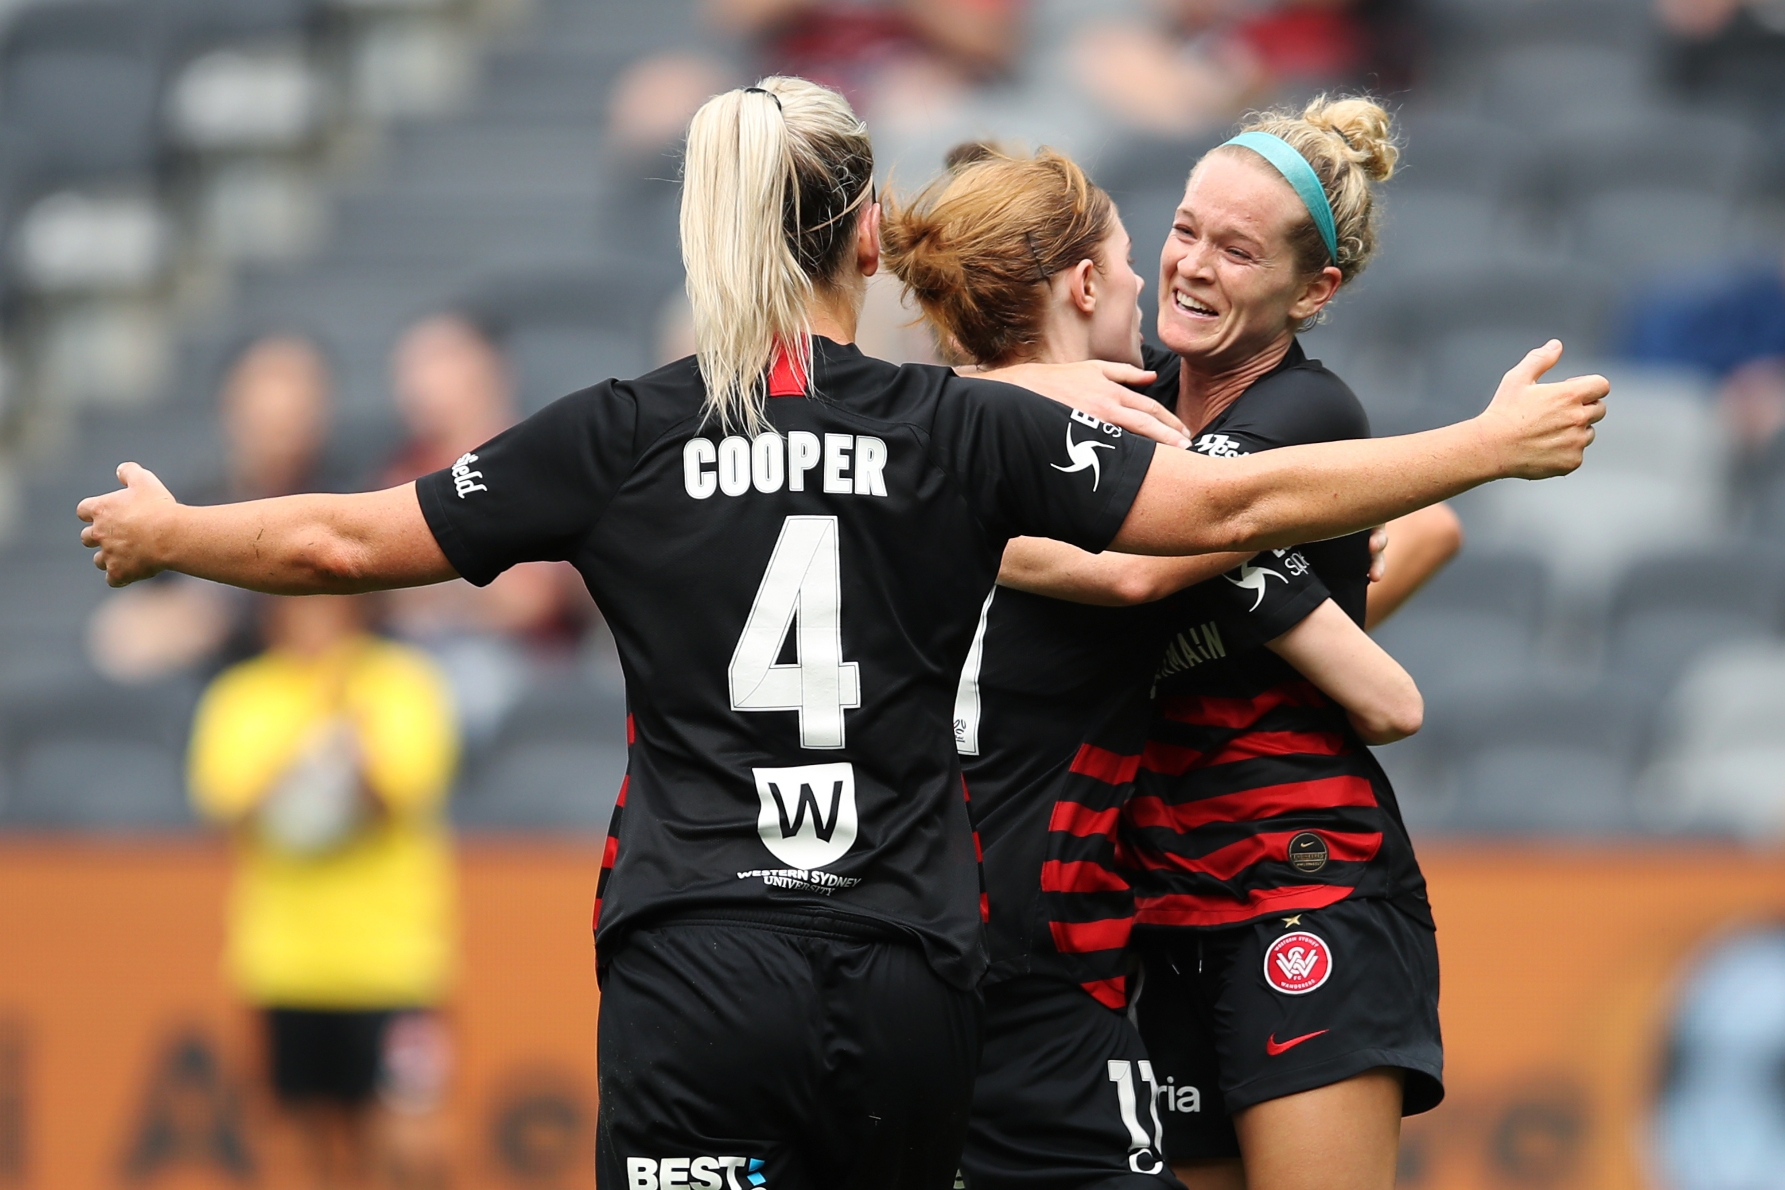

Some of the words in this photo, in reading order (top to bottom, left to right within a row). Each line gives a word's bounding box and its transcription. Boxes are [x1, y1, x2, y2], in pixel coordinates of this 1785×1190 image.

[683, 431, 888, 499] COOPER
[728, 515, 861, 749] 4
[768, 780, 843, 843] W
[737, 869, 808, 880] WESTERN
[811, 870, 861, 888] SYDNEY
[763, 875, 835, 896] UNIVERSITY
[1273, 936, 1297, 951] WESTERN
[1298, 936, 1319, 948] SYDNEY
[1280, 978, 1316, 989] WANDERERS
[627, 1156, 747, 1190] BEST
